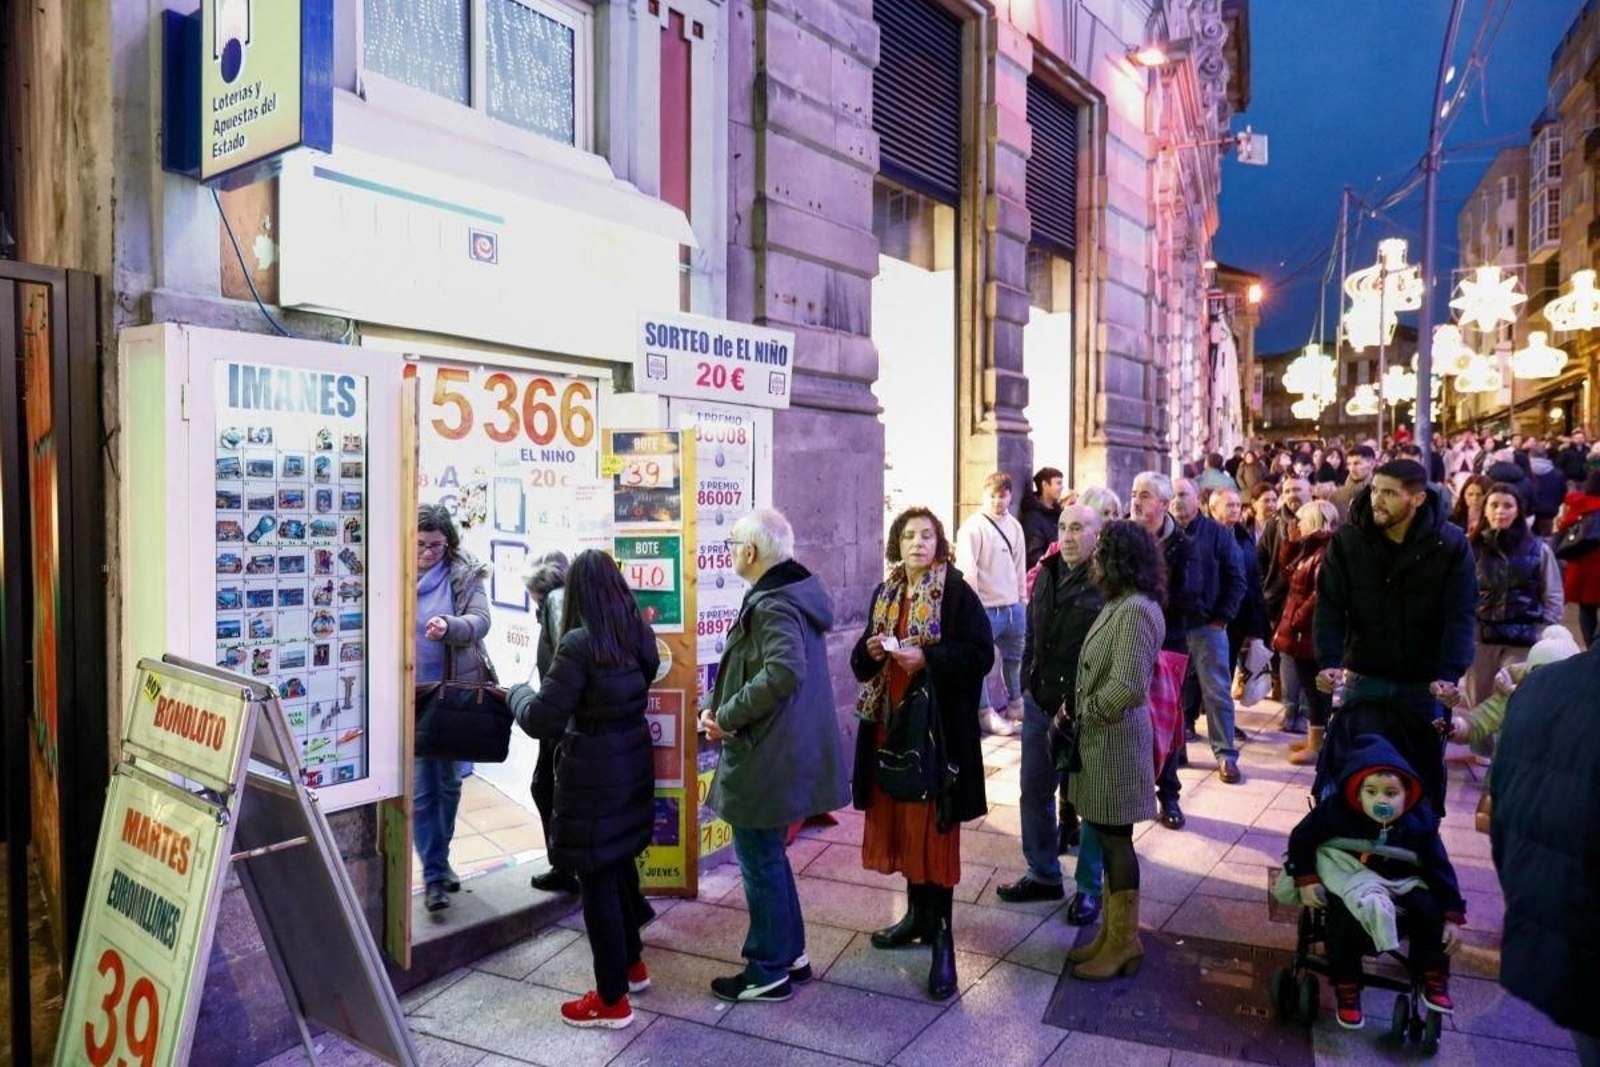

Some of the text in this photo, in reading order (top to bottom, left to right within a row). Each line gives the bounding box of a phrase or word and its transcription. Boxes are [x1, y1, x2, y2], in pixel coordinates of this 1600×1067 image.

[255, 80, 262, 99] y
[213, 92, 276, 136] Apuestas del
[213, 132, 245, 158] Estado
[645, 322, 788, 367] SORTEO de EL NIÑO
[229, 363, 356, 418] IMANES
[404, 364, 594, 447] 5366
[521, 448, 537, 461] EL
[531, 468, 556, 487] 20
[627, 462, 660, 486] 39
[707, 481, 740, 490] PREMIO
[697, 490, 742, 505] 86007
[635, 542, 660, 554] BOTE
[707, 609, 739, 619] PREMIO
[697, 618, 735, 636] 8897
[648, 697, 661, 711] TE
[153, 695, 227, 751] BONOLOTO
[121, 807, 191, 876] MARTES
[645, 867, 681, 878] JUEVES
[106, 868, 180, 951] EUROMILLONES
